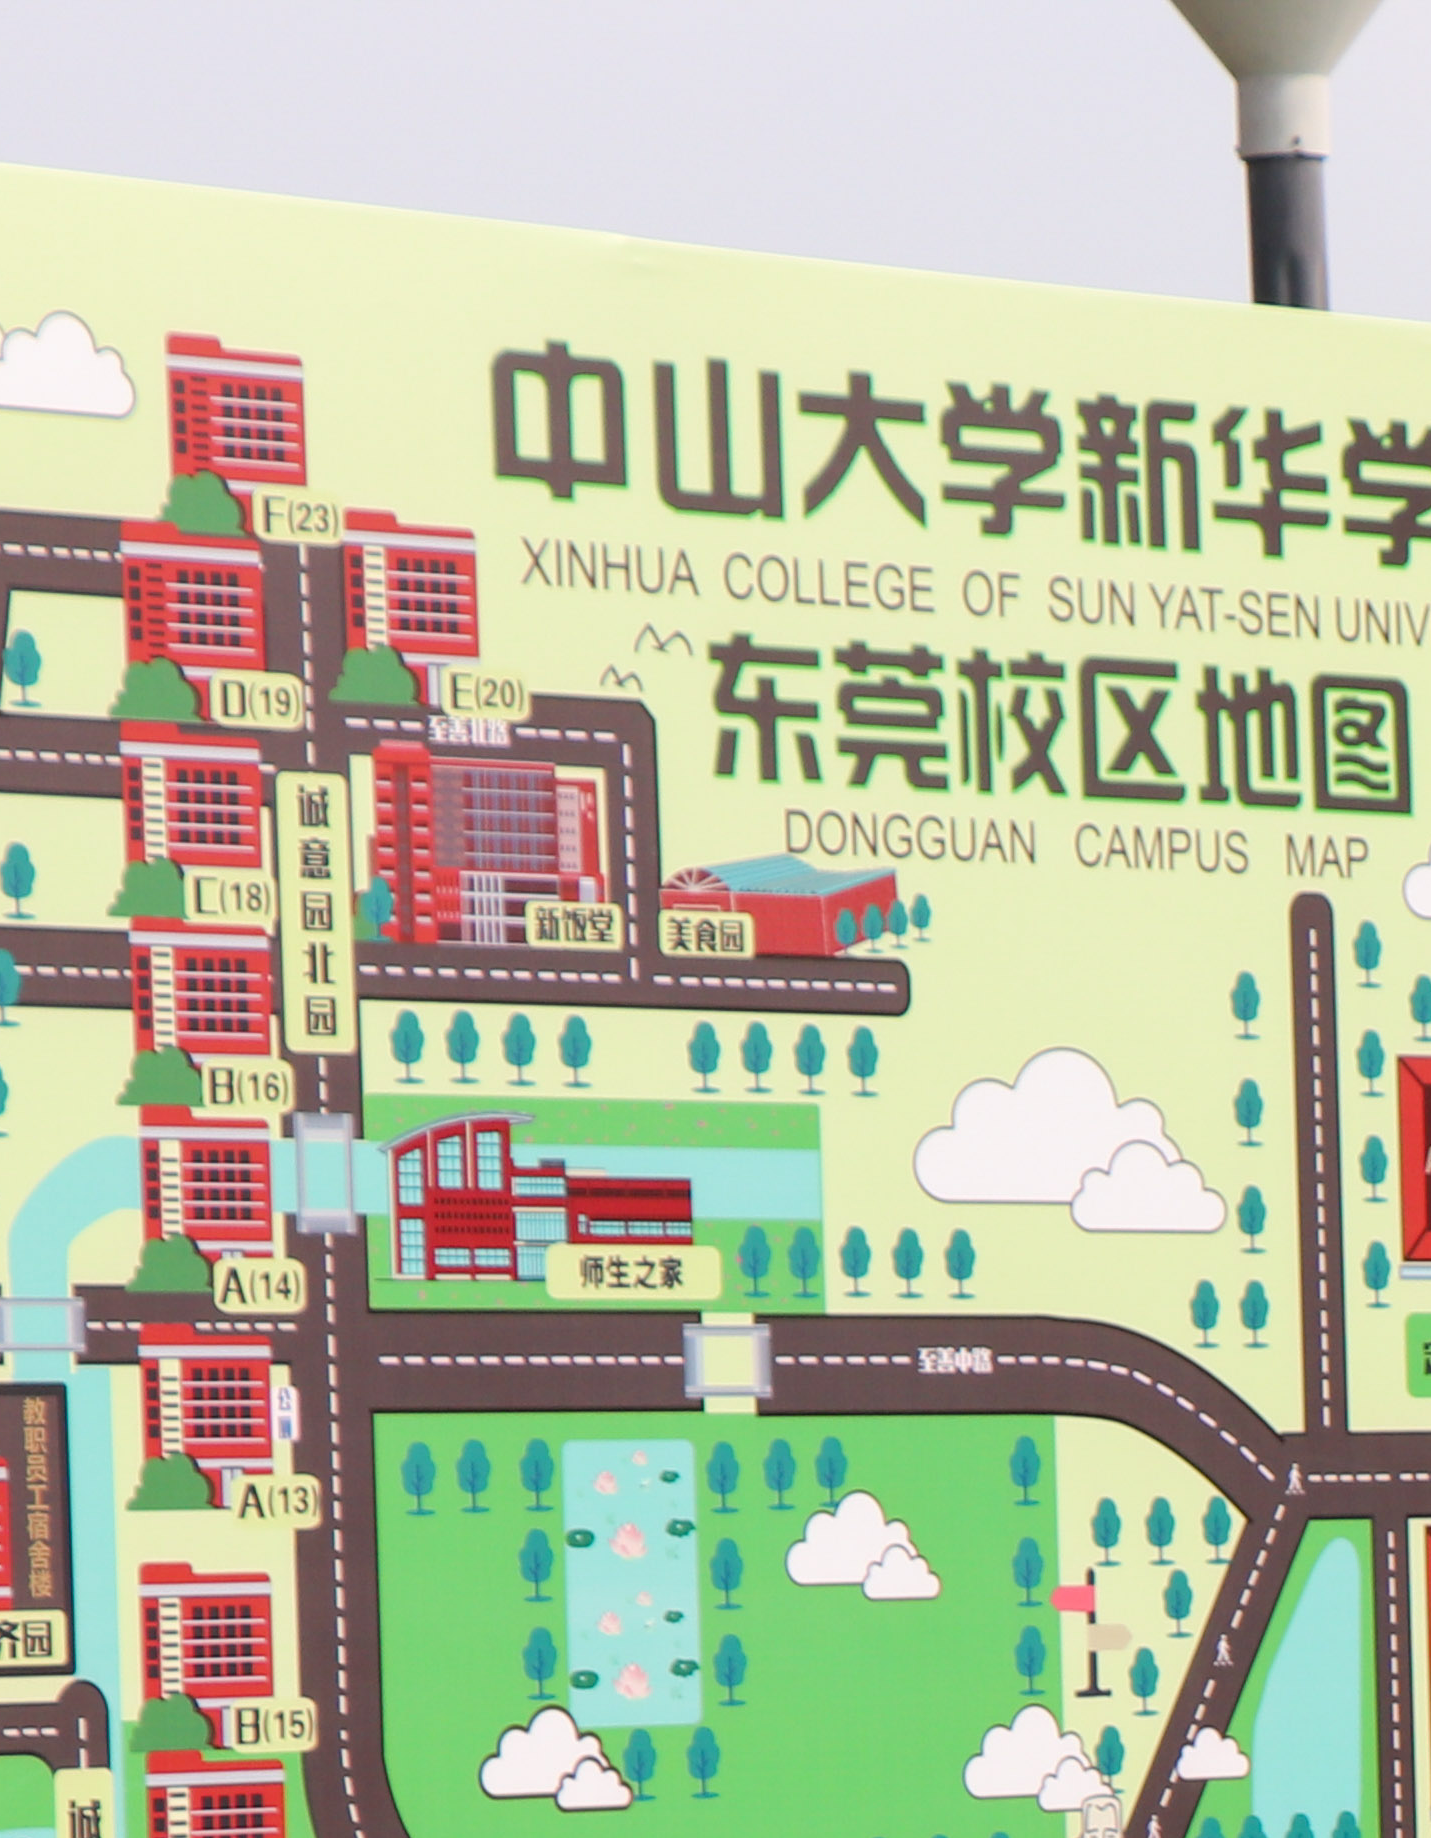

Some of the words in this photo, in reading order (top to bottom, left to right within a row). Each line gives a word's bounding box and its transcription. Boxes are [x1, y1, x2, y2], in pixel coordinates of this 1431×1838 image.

[262, 498, 337, 536] F(23)
[521, 536, 699, 598] XINHUA
[722, 550, 935, 615] COLLEGE
[963, 570, 1021, 617] OF
[1047, 575, 1138, 628] SUN
[1148, 584, 1321, 640] YAT-SEN
[221, 681, 298, 719] D(19)
[452, 675, 524, 712] E(20)
[708, 631, 1413, 816] 东莞校区地图
[784, 807, 1037, 865] DONGGUAN
[1074, 821, 1251, 875] CAMPUS
[1285, 832, 1370, 880] MAP
[297, 784, 337, 1037] 诚意园北园
[534, 908, 615, 943] 新饭堂
[667, 917, 745, 953] 美食园
[209, 1067, 290, 1107] B(16)
[220, 1267, 301, 1304] A(14)
[579, 1256, 684, 1289] 师生之家
[238, 1482, 321, 1521] A(13)
[237, 1706, 314, 1746] B(15)
